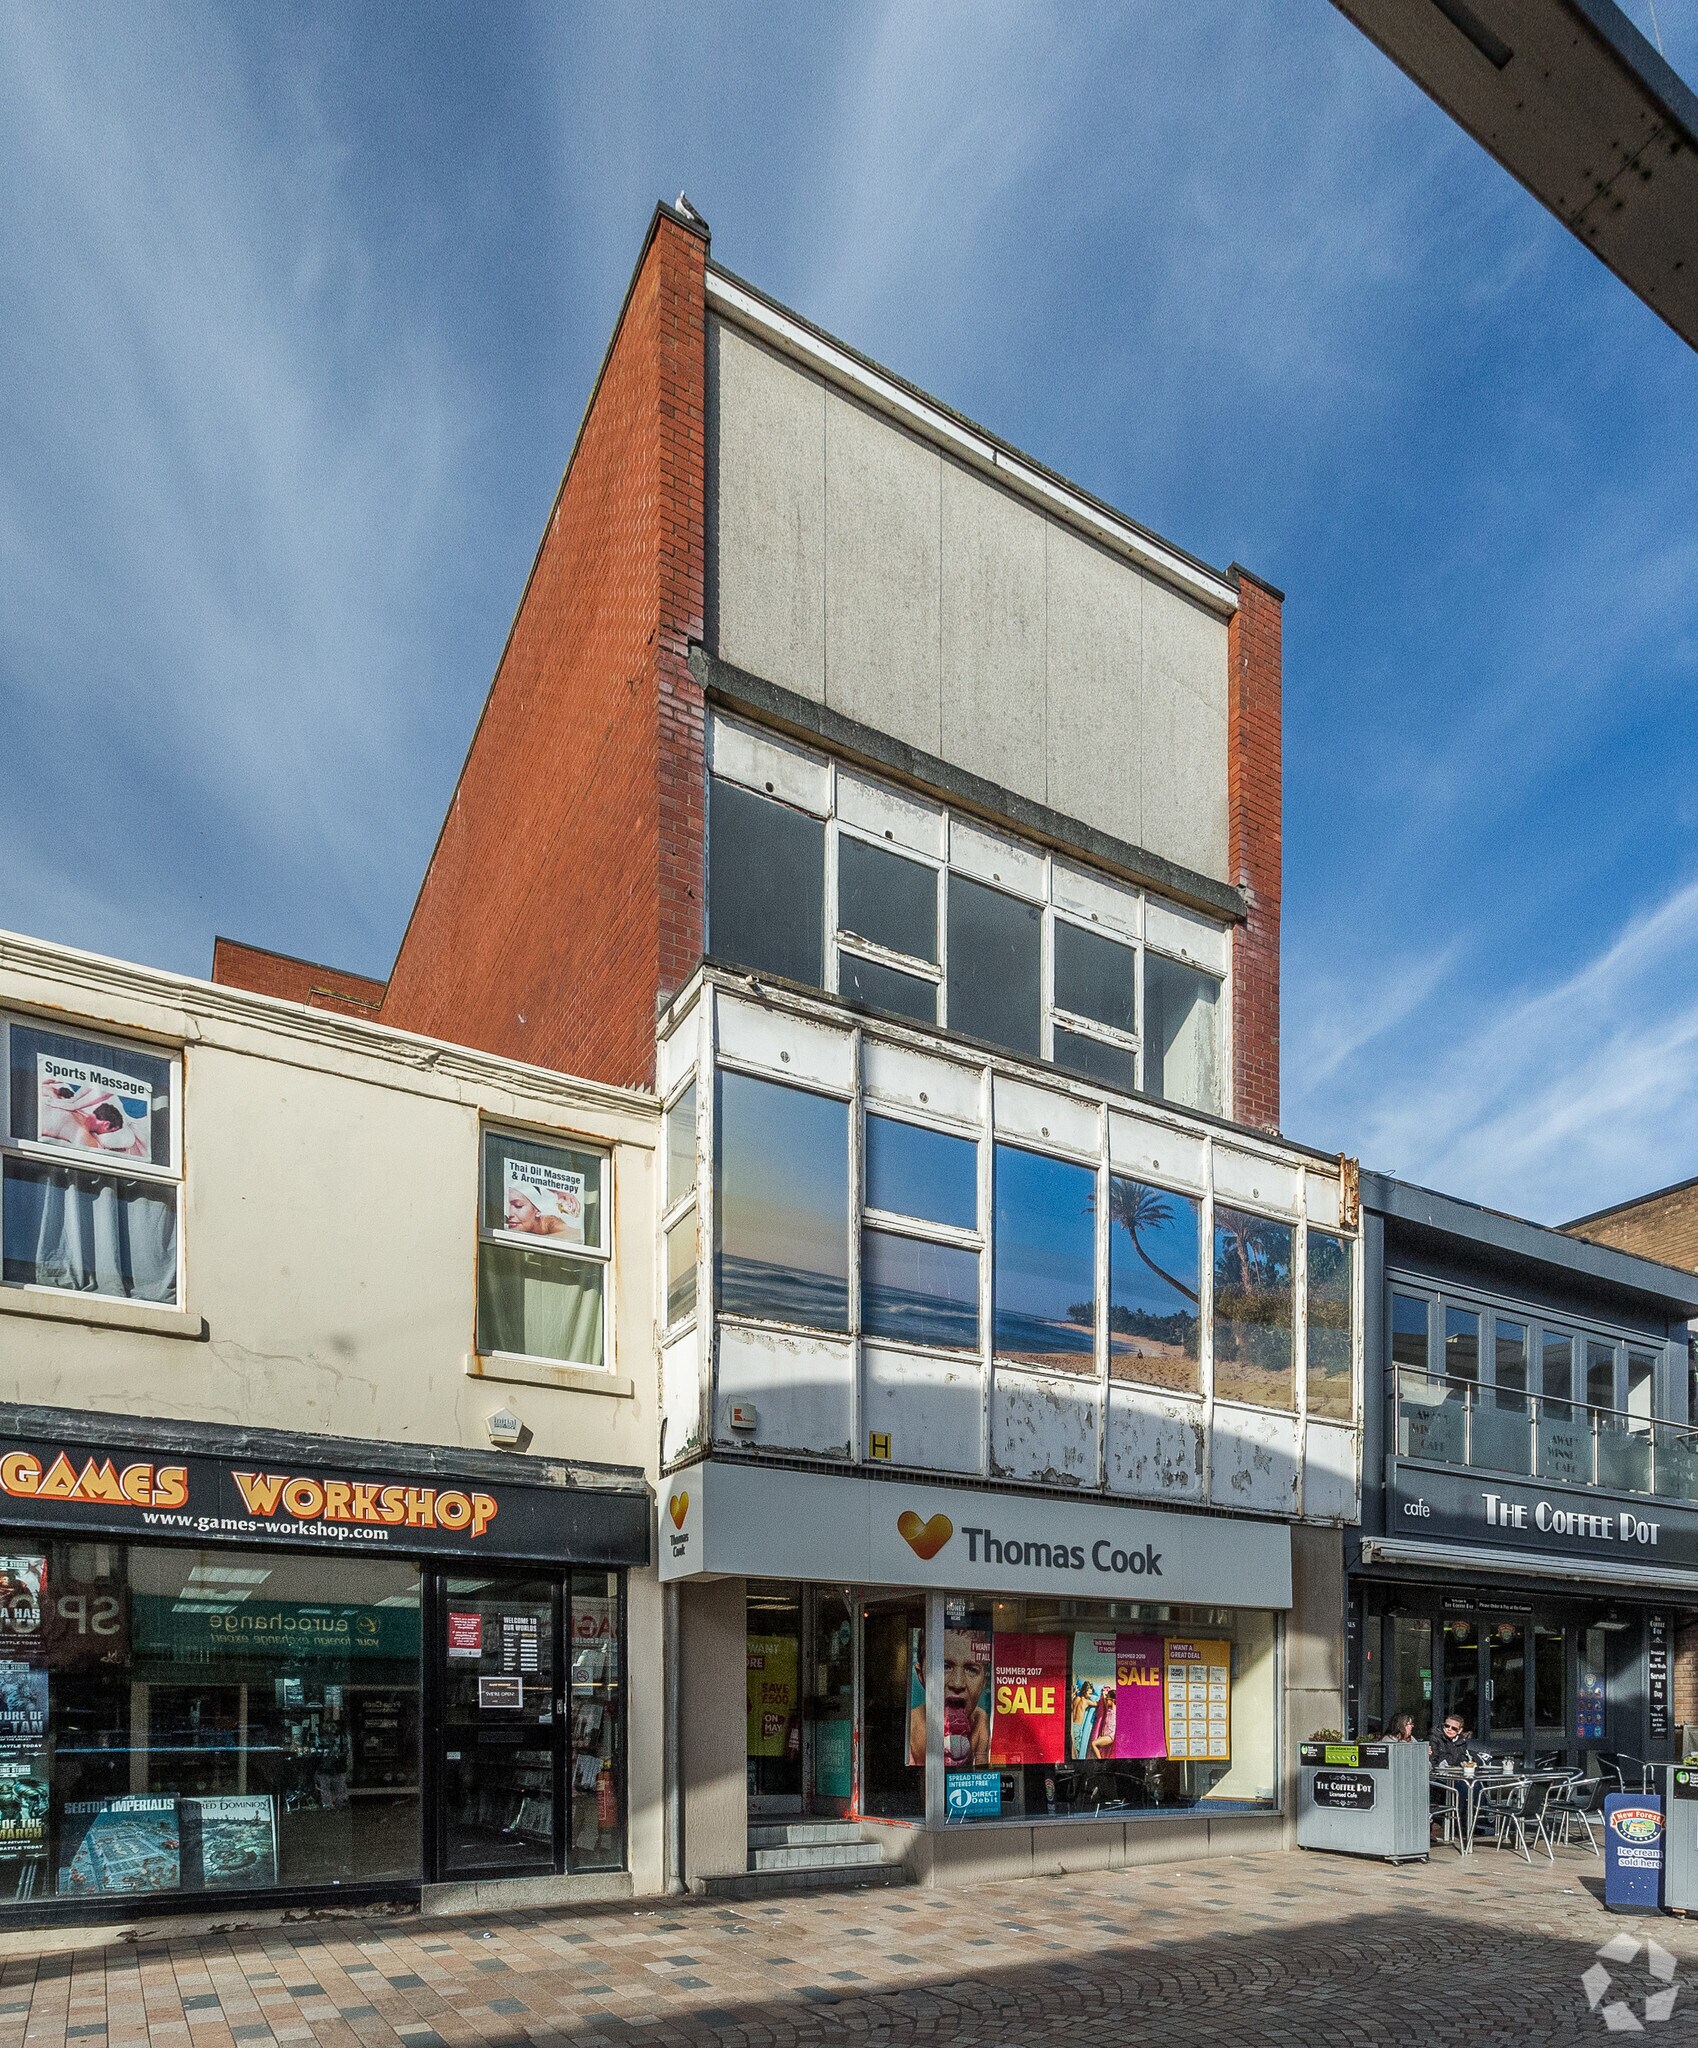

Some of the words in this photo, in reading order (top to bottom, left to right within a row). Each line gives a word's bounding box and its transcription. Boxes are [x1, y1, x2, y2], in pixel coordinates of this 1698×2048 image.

[45, 1061, 86, 1081] Sports
[90, 1071, 145, 1095] Massage
[510, 1162, 528, 1172] Thai
[530, 1166, 541, 1176] Oil
[544, 1169, 581, 1185] Massage
[511, 1171, 519, 1180] &
[520, 1173, 579, 1194] Aromatherapy
[872, 1434, 889, 1458] H
[0, 1450, 189, 1509] GAMES
[231, 1471, 498, 1539] WORKSHOP
[1404, 1499, 1430, 1518] cafe
[1482, 1493, 1528, 1529] THE
[1535, 1501, 1613, 1540] COFFEE
[1619, 1512, 1661, 1545] POT
[142, 1512, 389, 1540] www.games-workshop.com
[670, 1533, 689, 1546] Thomas
[673, 1544, 686, 1558] Cook
[961, 1527, 1085, 1570] Thomas
[1092, 1540, 1163, 1576] Cook
[14, 1608, 41, 1618] HAS
[503, 1616, 529, 1624] WELCOME
[975, 1643, 991, 1651] WANT
[982, 1653, 991, 1661] ALL
[996, 1666, 1026, 1675] SUMMER
[996, 1677, 1014, 1685] NOW
[1015, 1677, 1027, 1685] ON
[1117, 1667, 1160, 1686] SALE
[762, 1683, 788, 1694] SAVE
[996, 1686, 1055, 1715] SALE
[29, 1711, 43, 1720] OF
[764, 1714, 778, 1722] ON
[764, 1723, 783, 1732] MAY
[1330, 1782, 1356, 1791] COFFEE
[1356, 1783, 1372, 1792] POT
[64, 1802, 107, 1814] SECTOR
[111, 1798, 175, 1812] IMPERIALIS
[219, 1800, 268, 1811] DOMINION
[1617, 1811, 1633, 1820] New
[1635, 1811, 1662, 1822] Forest
[2, 1821, 17, 1829] OF
[20, 1819, 42, 1828] THE
[1618, 1847, 1632, 1856] Ice
[1633, 1849, 1663, 1858] cream
[1619, 1858, 1638, 1866] sold
[1640, 1858, 1662, 1868] here
